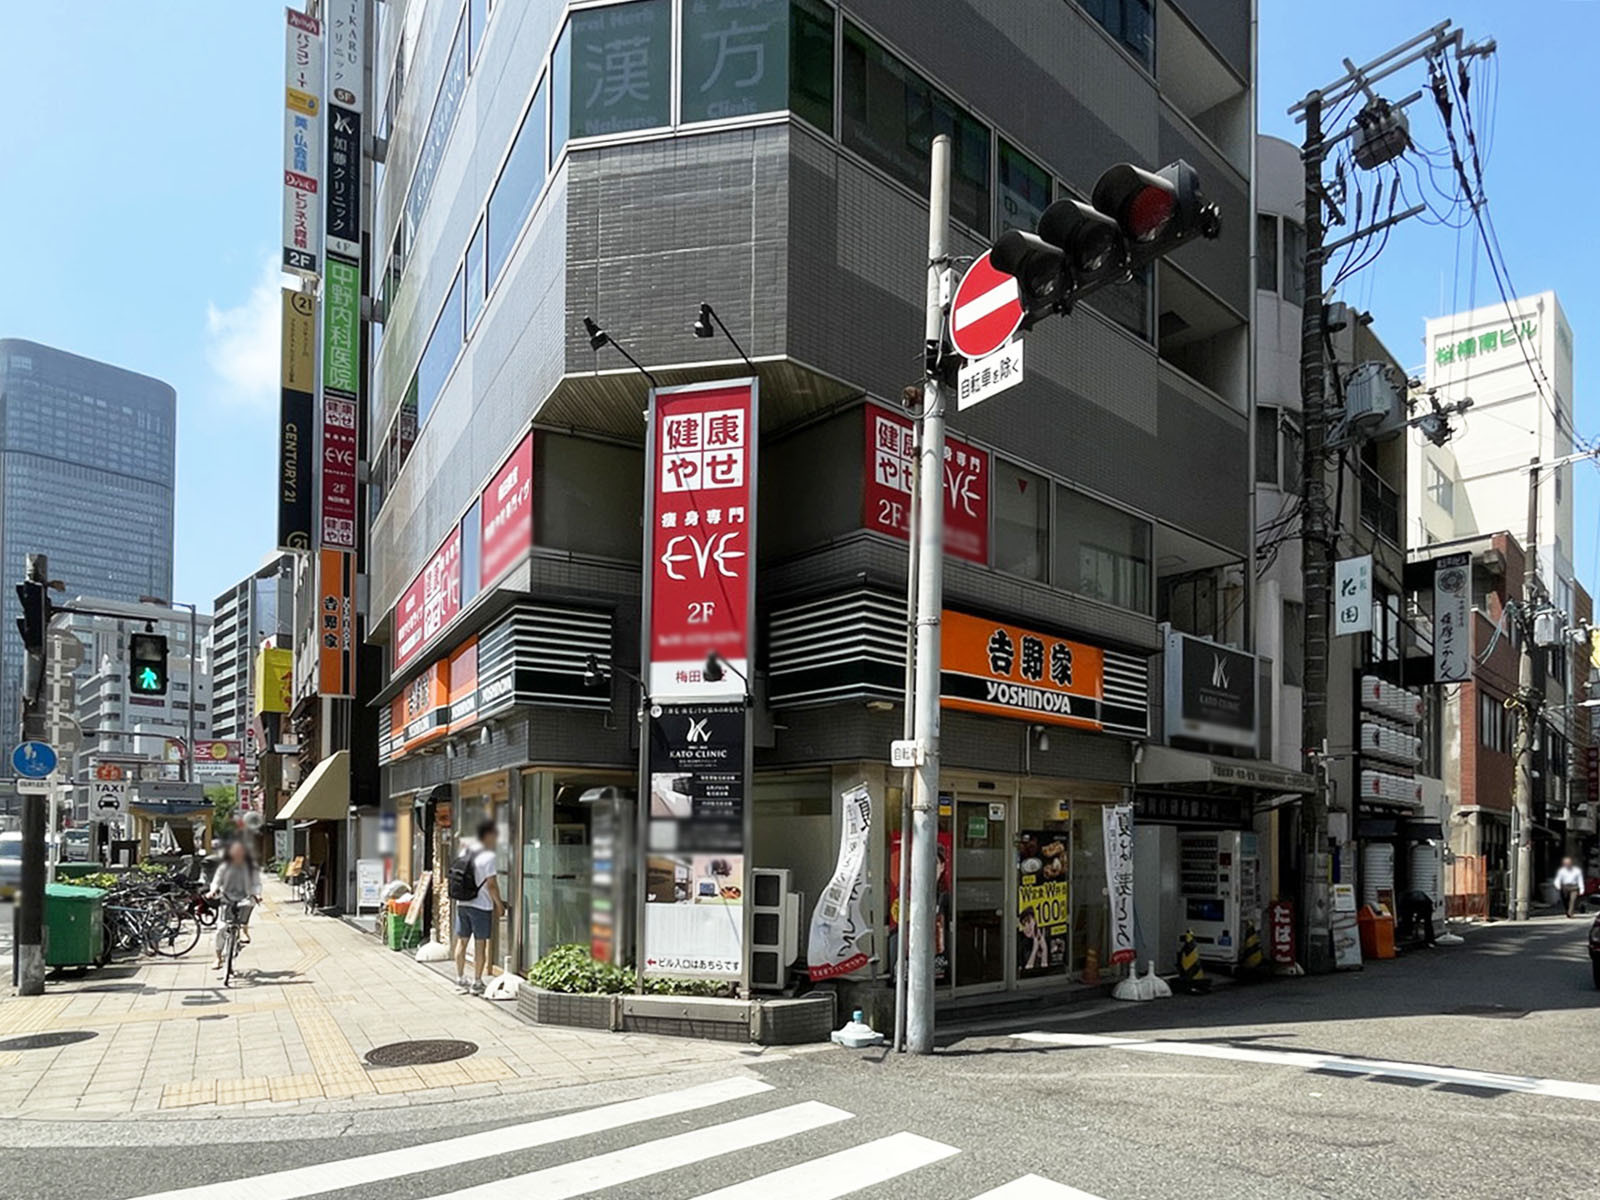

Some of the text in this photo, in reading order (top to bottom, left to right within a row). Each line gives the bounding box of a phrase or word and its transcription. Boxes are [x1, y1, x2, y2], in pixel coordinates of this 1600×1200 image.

[290, 252, 310, 267] 2F
[331, 264, 354, 390] 中野内科医院
[1435, 320, 1537, 367] 桜橋南ビル
[961, 356, 1019, 400] 自転車を除く
[666, 413, 740, 450] 健康
[284, 423, 298, 502] CENTURY 21
[666, 452, 740, 488] やせ
[878, 498, 904, 529] 2F
[661, 532, 745, 581] EVE
[324, 595, 338, 649] 吉野家
[687, 602, 716, 625] 2F
[986, 628, 1074, 686] 吉野家
[986, 681, 1072, 715] YOSHINOYA
[670, 750, 727, 758] KATO CLINIC
[96, 784, 125, 793] TAXI
[659, 958, 739, 970] ビル入口はあちらです
